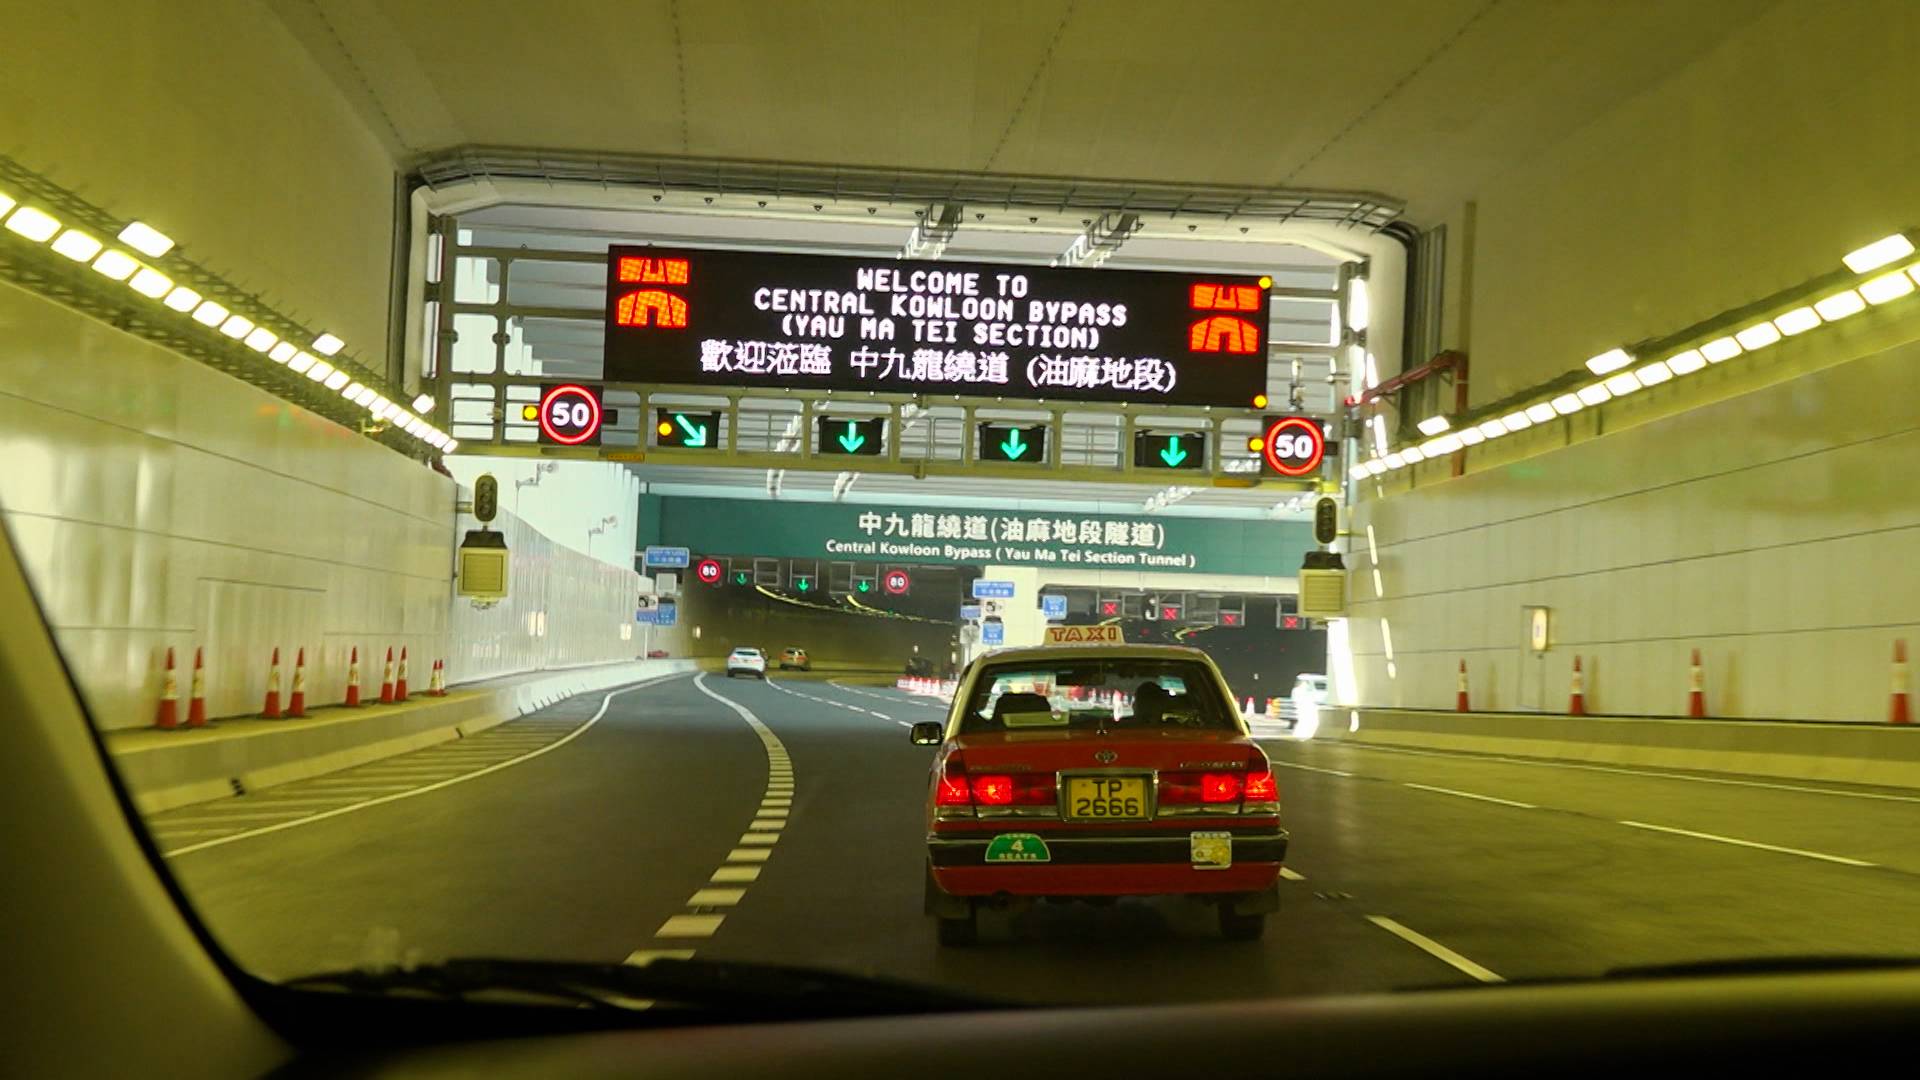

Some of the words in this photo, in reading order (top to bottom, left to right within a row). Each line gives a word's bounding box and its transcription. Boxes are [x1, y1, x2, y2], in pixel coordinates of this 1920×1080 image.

[857, 267, 980, 296] WELCOME
[996, 274, 1028, 298] TO
[754, 287, 875, 315] CENTRAL
[891, 293, 1014, 322] KOWLOON
[1028, 300, 1127, 327] BYPASS
[782, 313, 845, 338] (YAU
[860, 317, 895, 340] MA
[912, 319, 958, 343] TEI
[973, 322, 1099, 350] SECTION)
[850, 344, 1010, 384] 中九龍繞道
[1026, 353, 1177, 394] (油麻地段)
[551, 400, 590, 428] 50
[1275, 433, 1314, 459] 50
[826, 539, 876, 554] Central
[880, 542, 940, 557] Kowloon
[944, 544, 992, 561] Bypass
[1034, 549, 1057, 562] Ma
[1060, 549, 1081, 563] Tei
[1085, 550, 1135, 565] Section
[702, 565, 717, 576] 80
[890, 576, 904, 588] 80
[1049, 627, 1117, 642] TAXI
[1092, 779, 1123, 799] TP
[1076, 797, 1139, 817] 2666
[1011, 839, 1025, 852] 4
